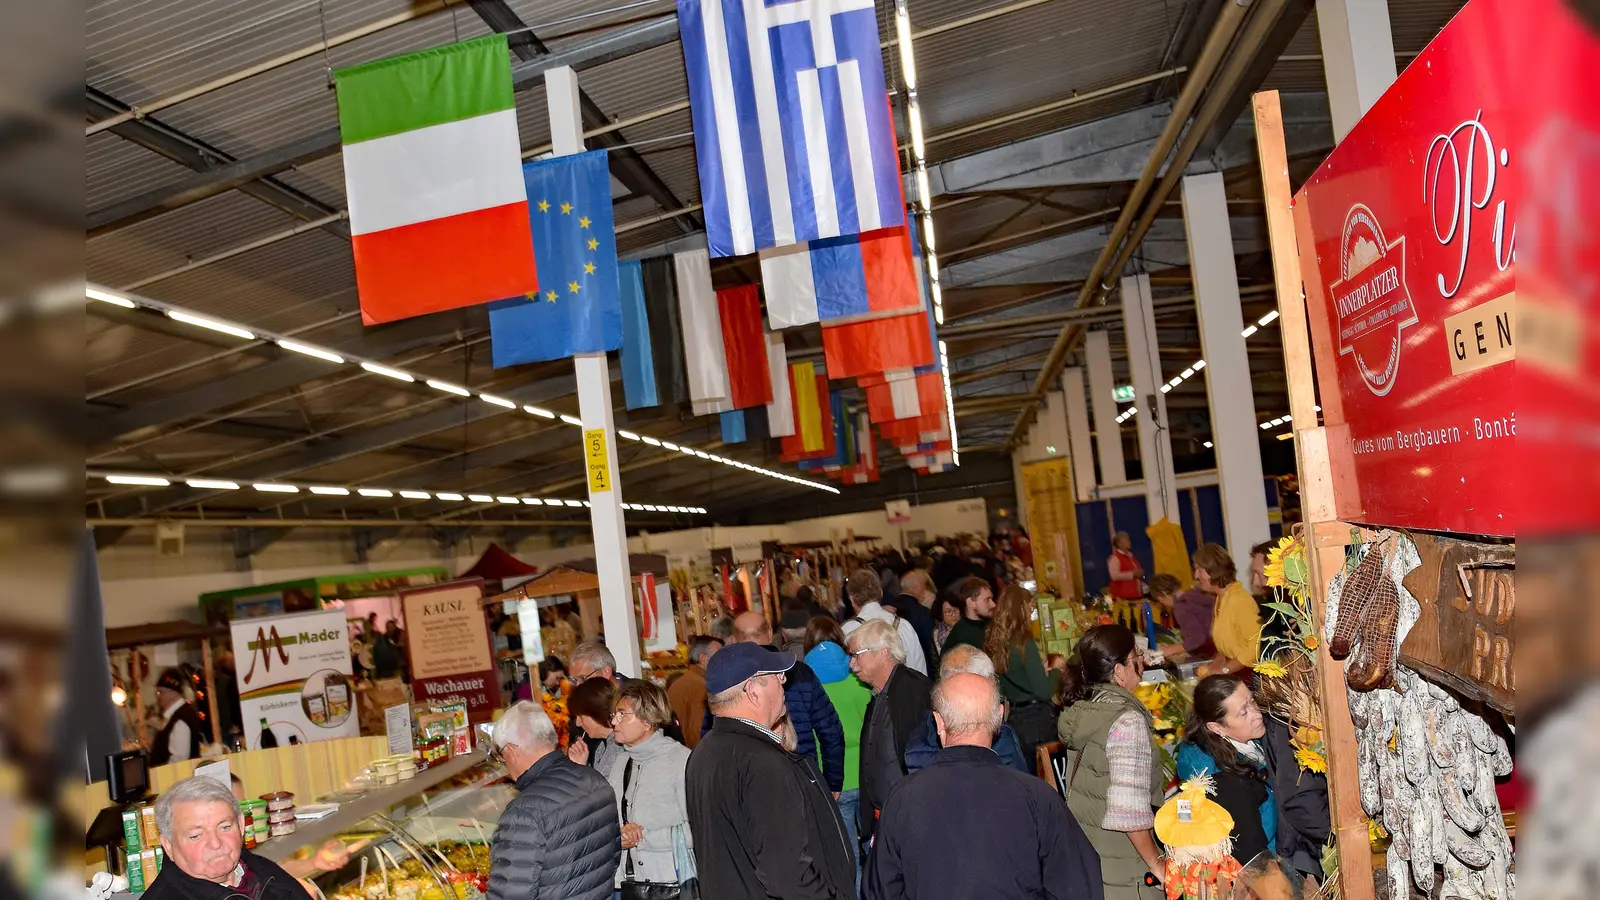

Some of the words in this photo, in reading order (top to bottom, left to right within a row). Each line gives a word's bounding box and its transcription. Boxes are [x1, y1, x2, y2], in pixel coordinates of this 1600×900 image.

[1423, 108, 1515, 298] Pi
[1339, 266, 1400, 319] INNERPLATZER
[1453, 311, 1513, 361] GEN
[593, 439, 600, 451] 5
[1351, 437, 1374, 455] Gutes
[1376, 436, 1395, 451] vom
[1396, 426, 1461, 452] Bergbauern
[596, 470, 603, 482] 4
[423, 600, 466, 616] KAUSL
[298, 628, 341, 645] Mader
[424, 679, 485, 696] Wachauer
